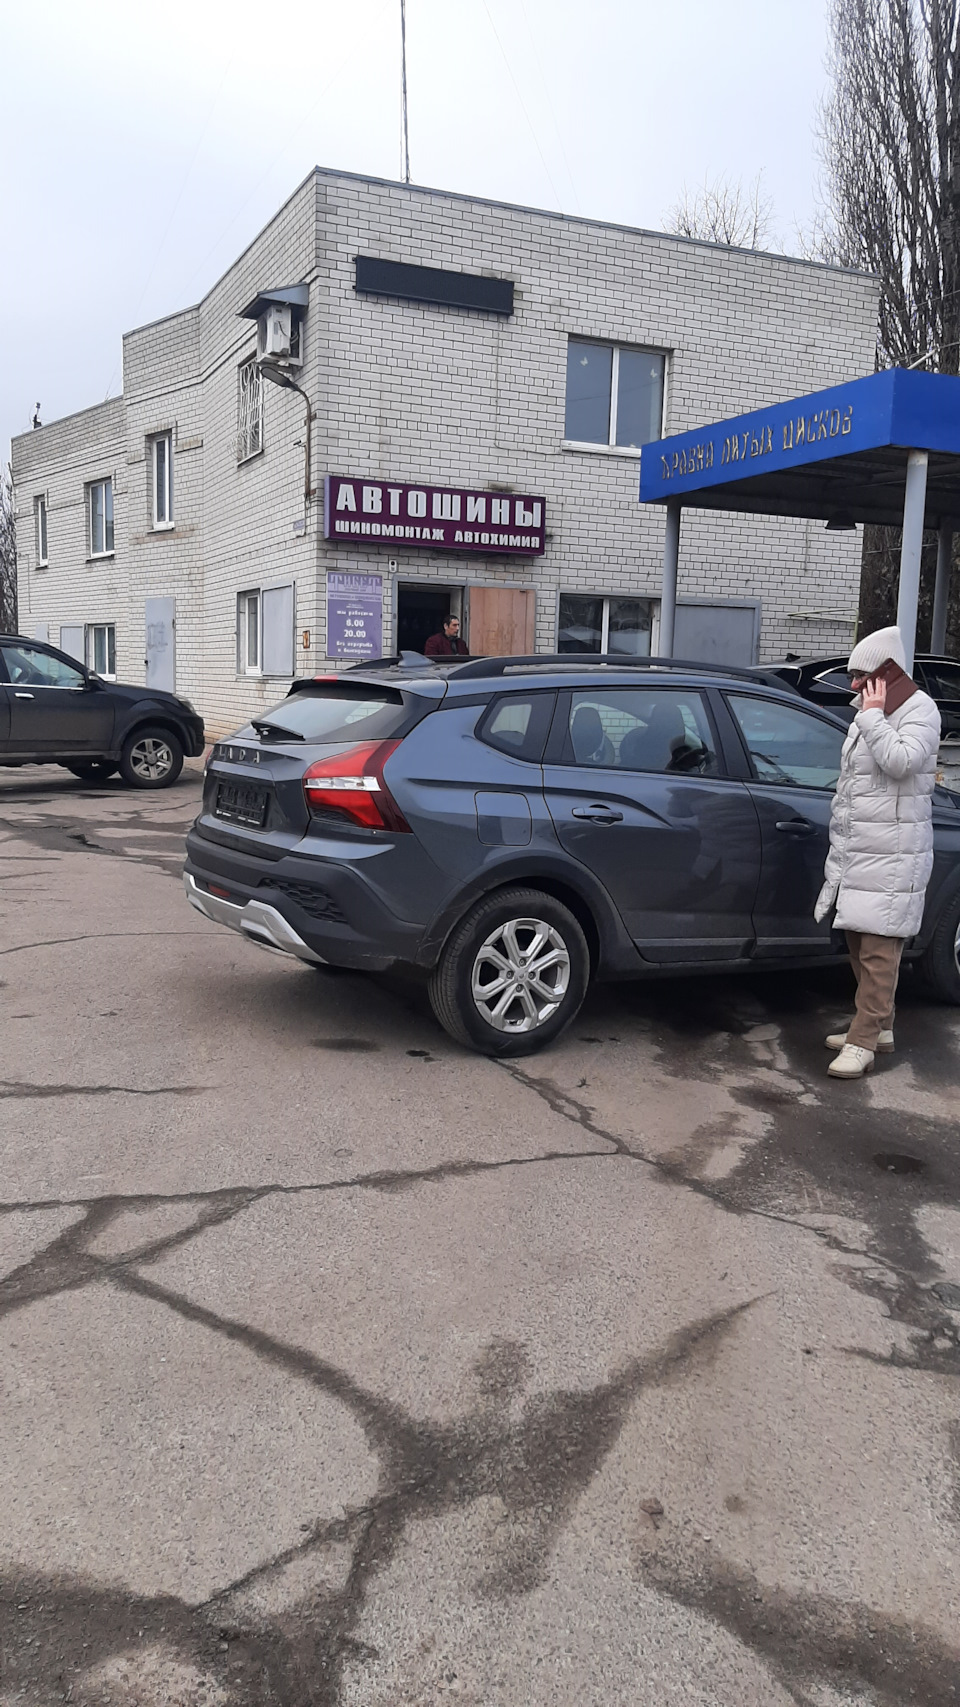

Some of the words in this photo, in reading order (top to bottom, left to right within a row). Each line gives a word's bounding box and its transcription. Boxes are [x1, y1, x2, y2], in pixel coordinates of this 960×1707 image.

[336, 483, 542, 528] АВТОШИНЫ
[335, 520, 445, 541] ШИНОМОНТАЖ
[454, 530, 540, 548] АВТОХИМИЯ
[346, 619, 364, 627] 8.00
[344, 629, 366, 638] 20.00
[219, 745, 260, 763] LADA
